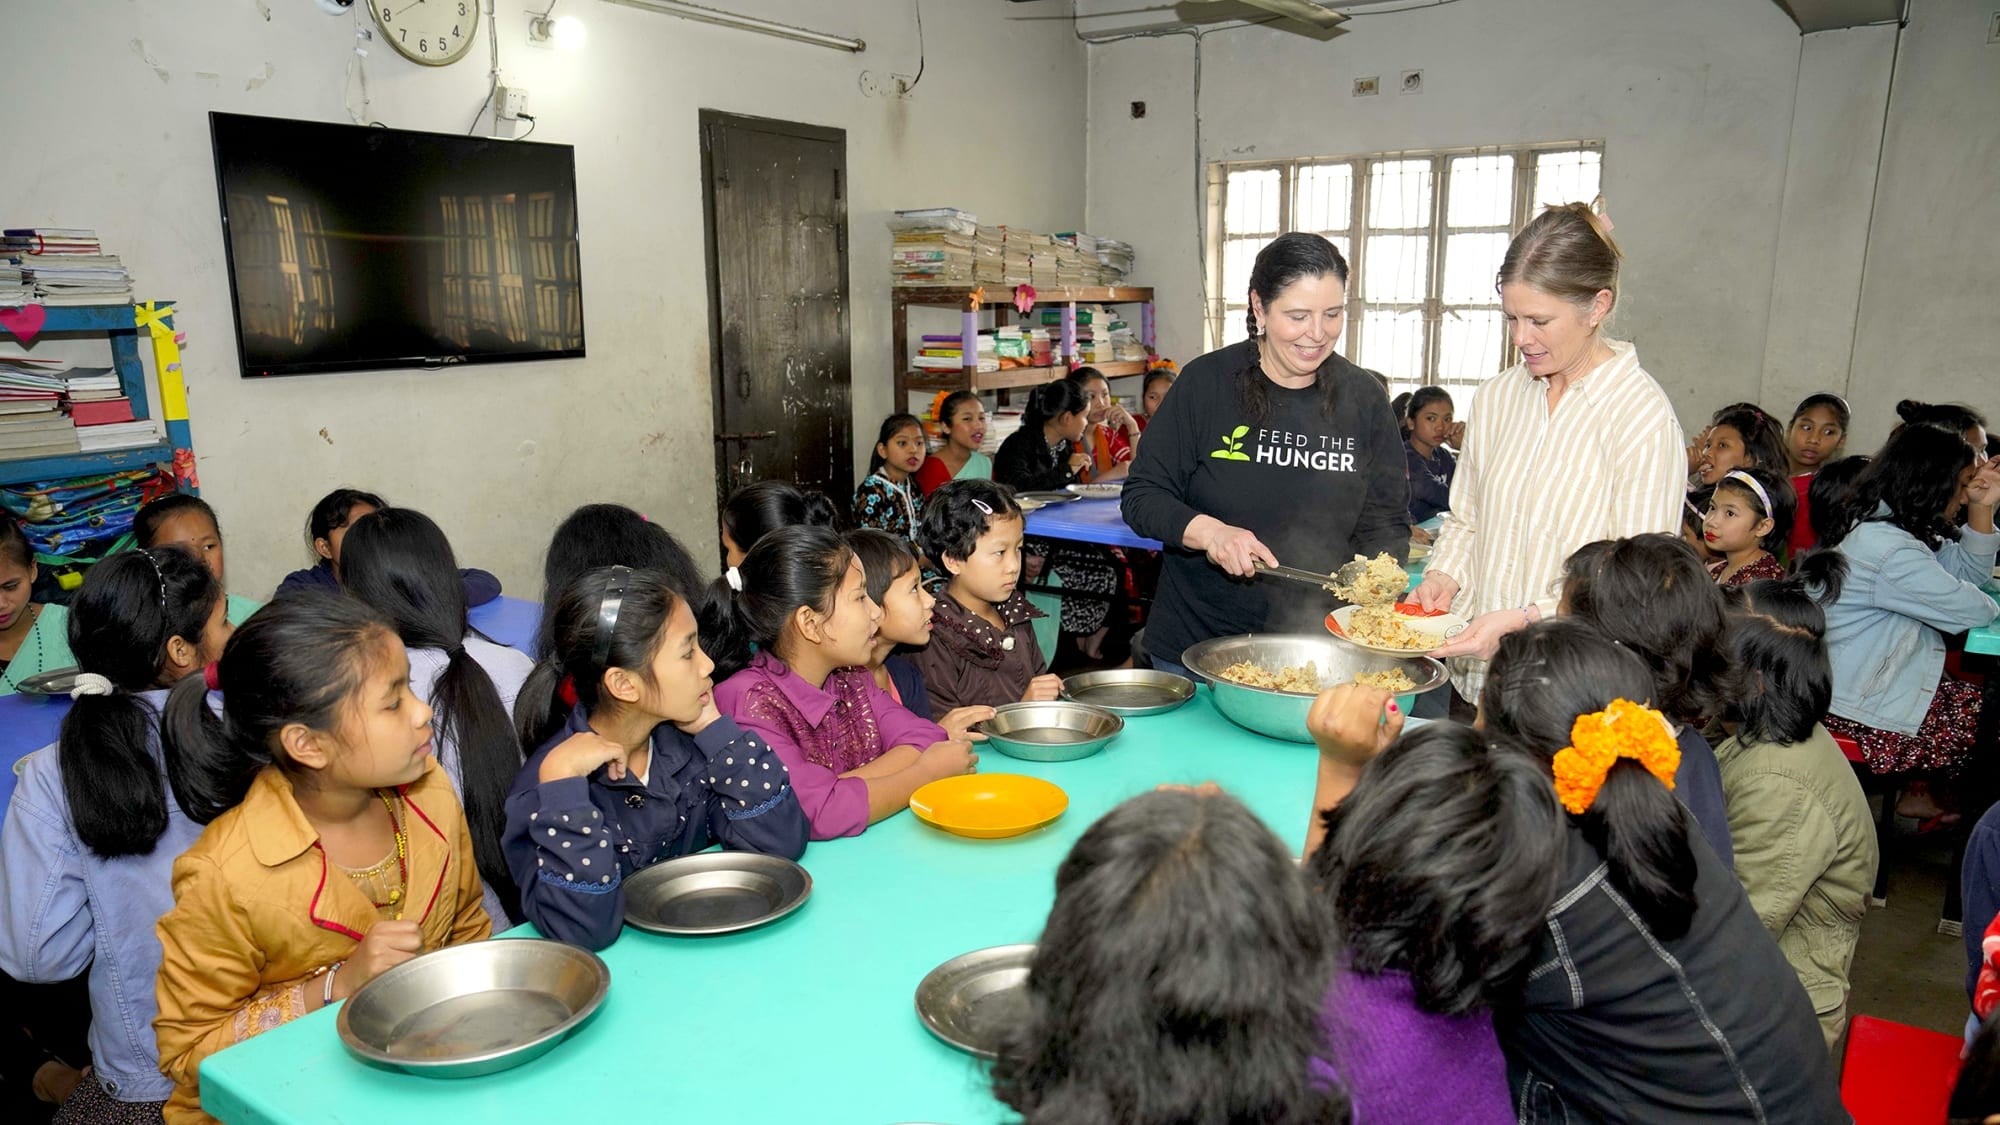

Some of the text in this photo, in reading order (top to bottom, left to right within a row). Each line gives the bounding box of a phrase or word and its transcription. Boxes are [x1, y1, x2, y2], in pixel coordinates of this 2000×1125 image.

[383, 8, 391, 22] 8
[458, 3, 466, 16] 3
[400, 28, 407, 42] 7
[452, 25, 460, 38] 4
[419, 39, 428, 53] 6
[439, 38, 447, 51] 5
[1258, 428, 1356, 451] FEED THE
